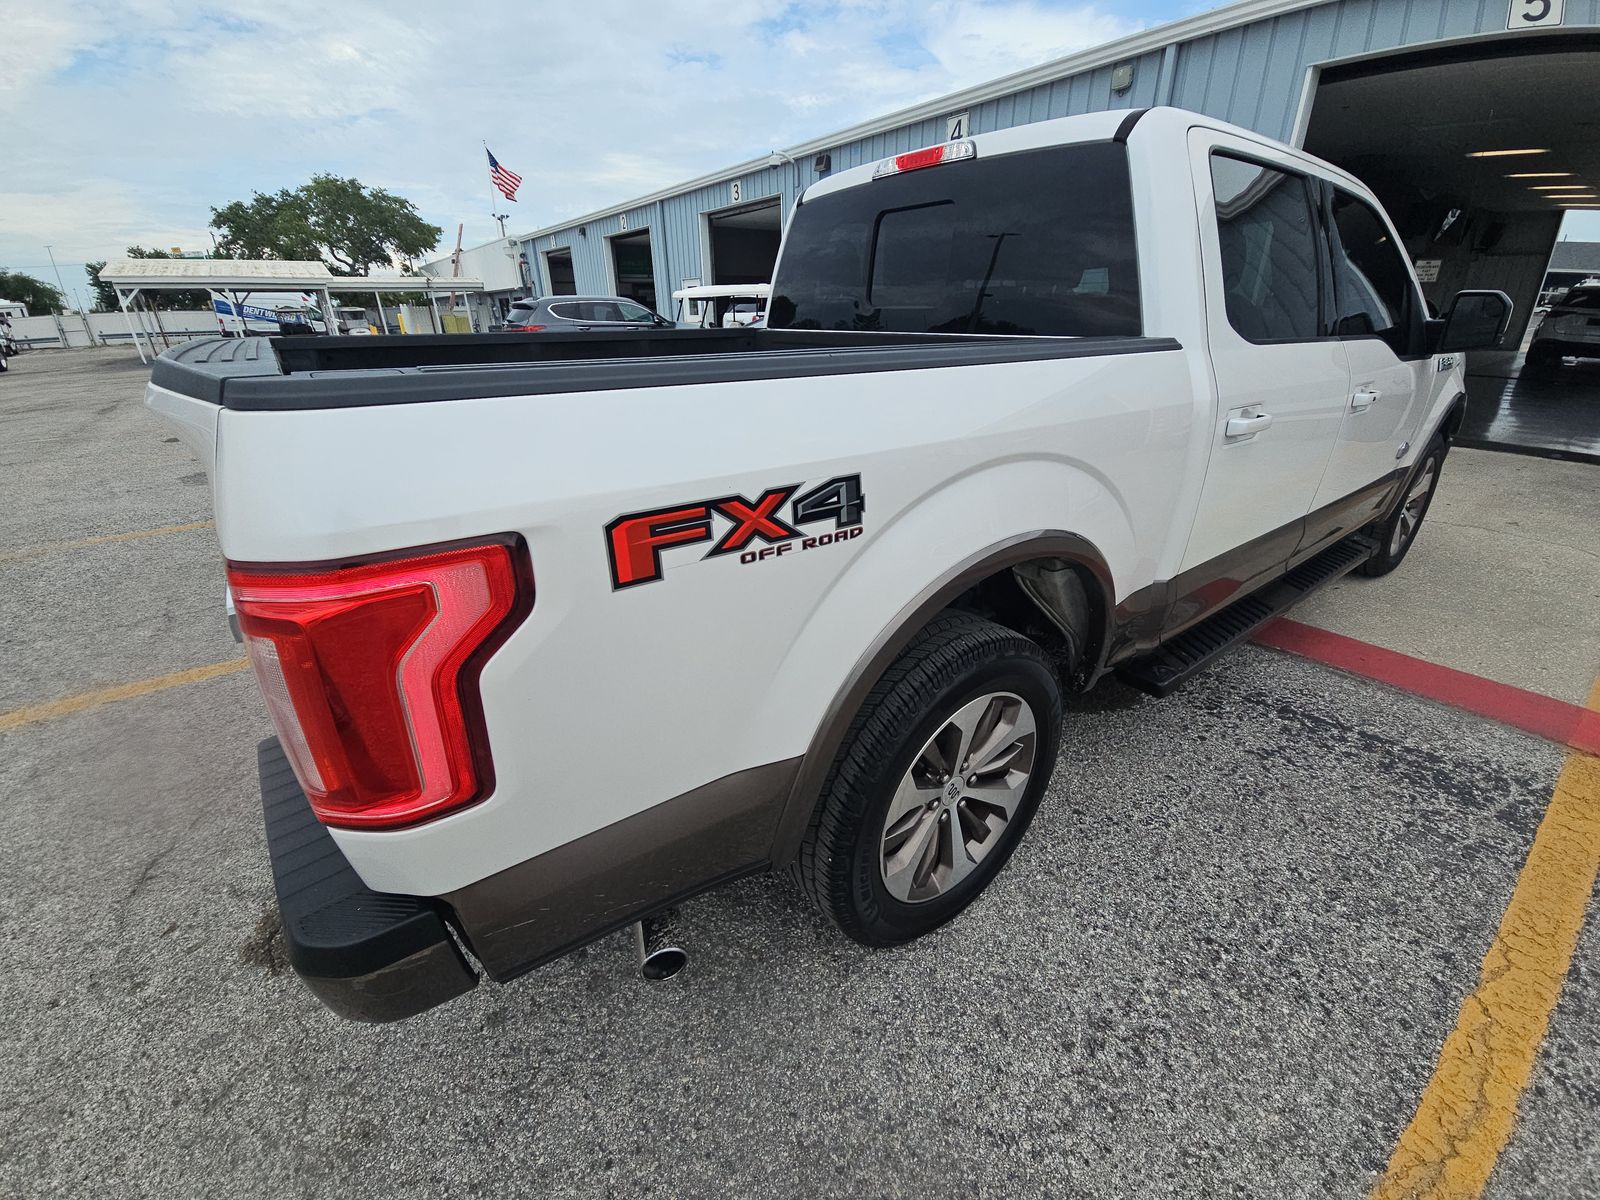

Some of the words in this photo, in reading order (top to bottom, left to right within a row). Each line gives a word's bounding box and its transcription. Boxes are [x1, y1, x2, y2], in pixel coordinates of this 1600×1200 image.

[1521, 0, 1552, 22] 5
[950, 118, 963, 141] 4
[733, 184, 740, 201] 3
[602, 472, 865, 593] FX4
[740, 543, 792, 565] OFF
[802, 526, 864, 551] ROAD
